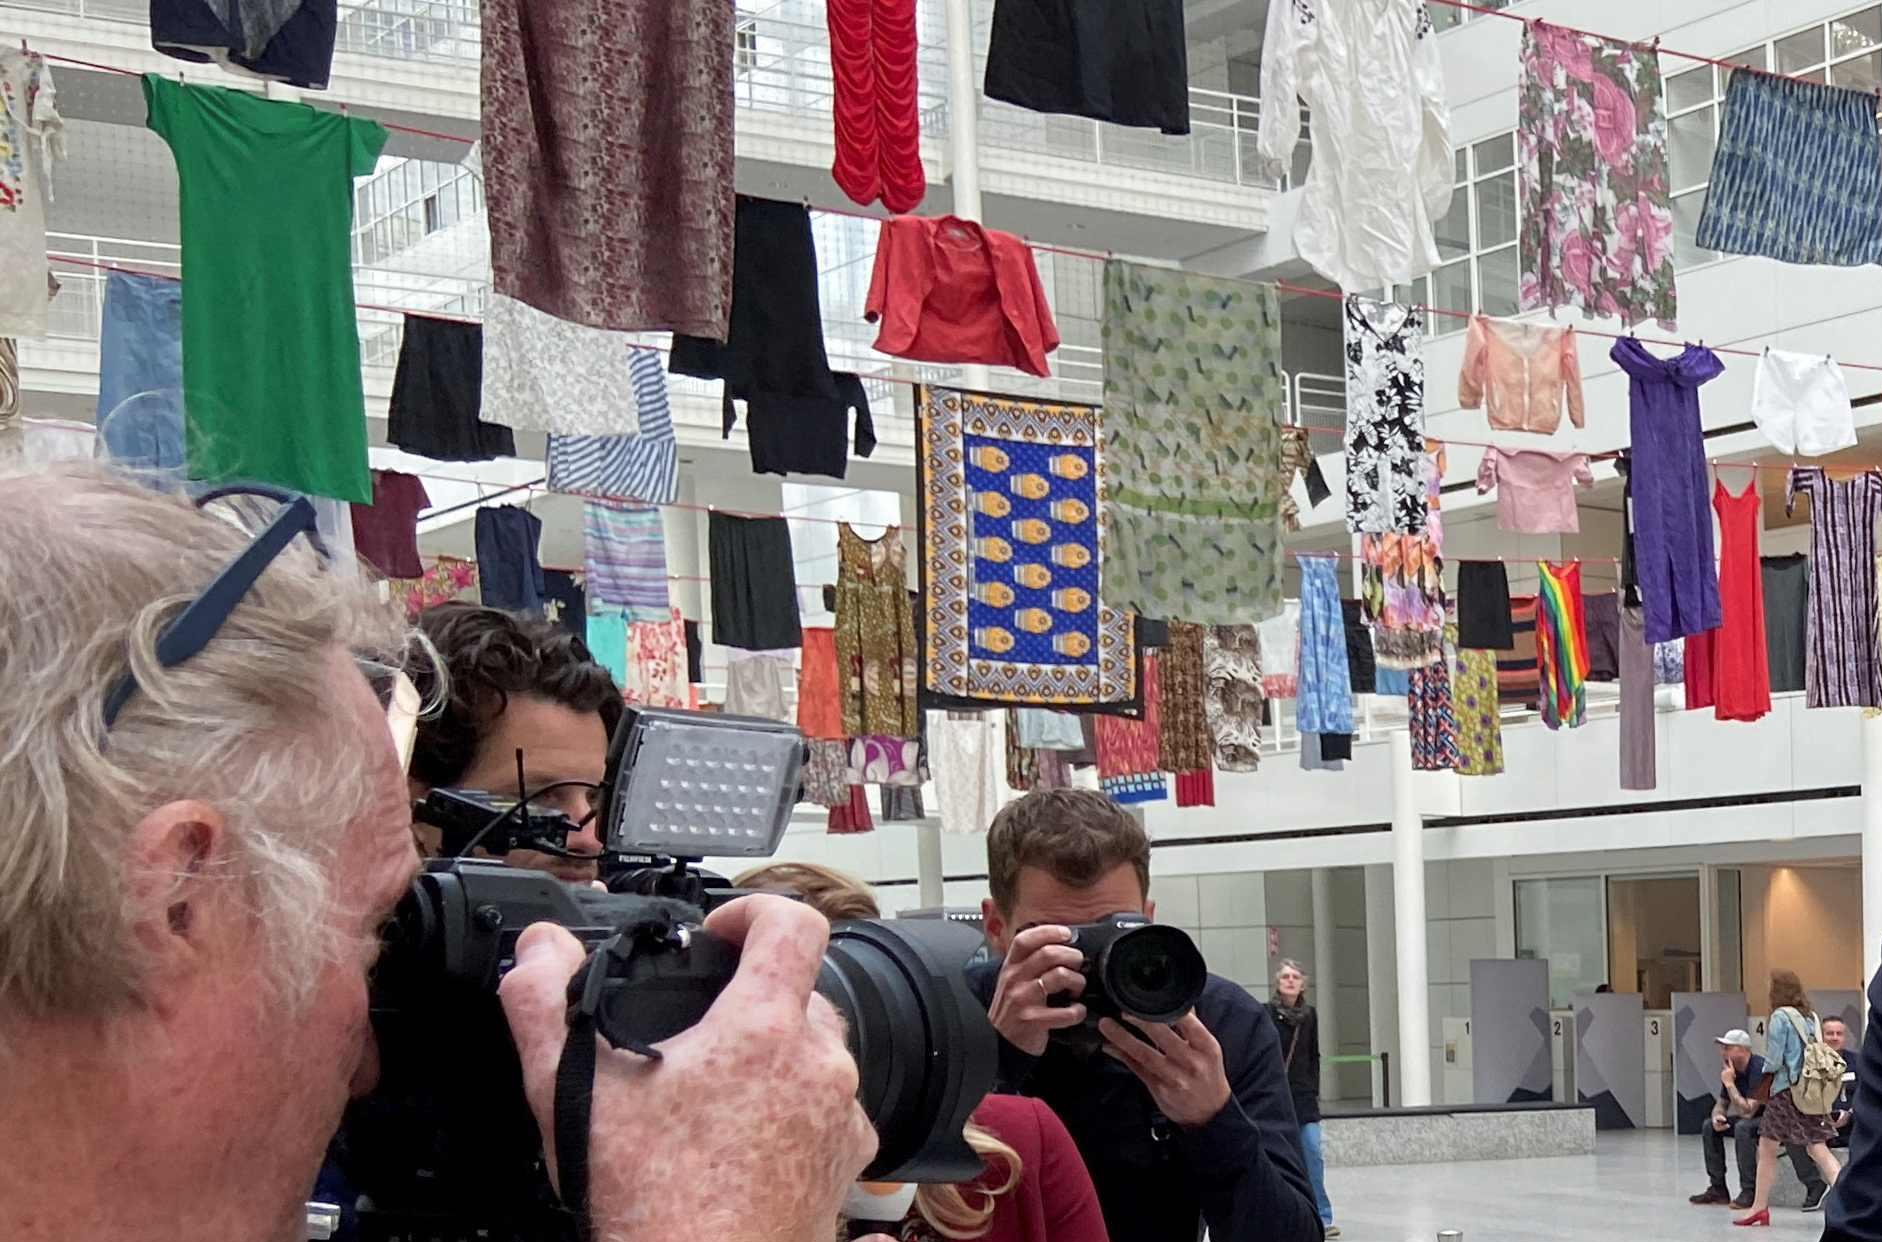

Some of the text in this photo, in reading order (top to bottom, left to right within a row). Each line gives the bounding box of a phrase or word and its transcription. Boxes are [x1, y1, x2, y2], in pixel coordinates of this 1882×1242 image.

[1554, 1021, 1561, 1036] 2
[1650, 1020, 1659, 1036] 3
[1756, 1020, 1764, 1036] 4
